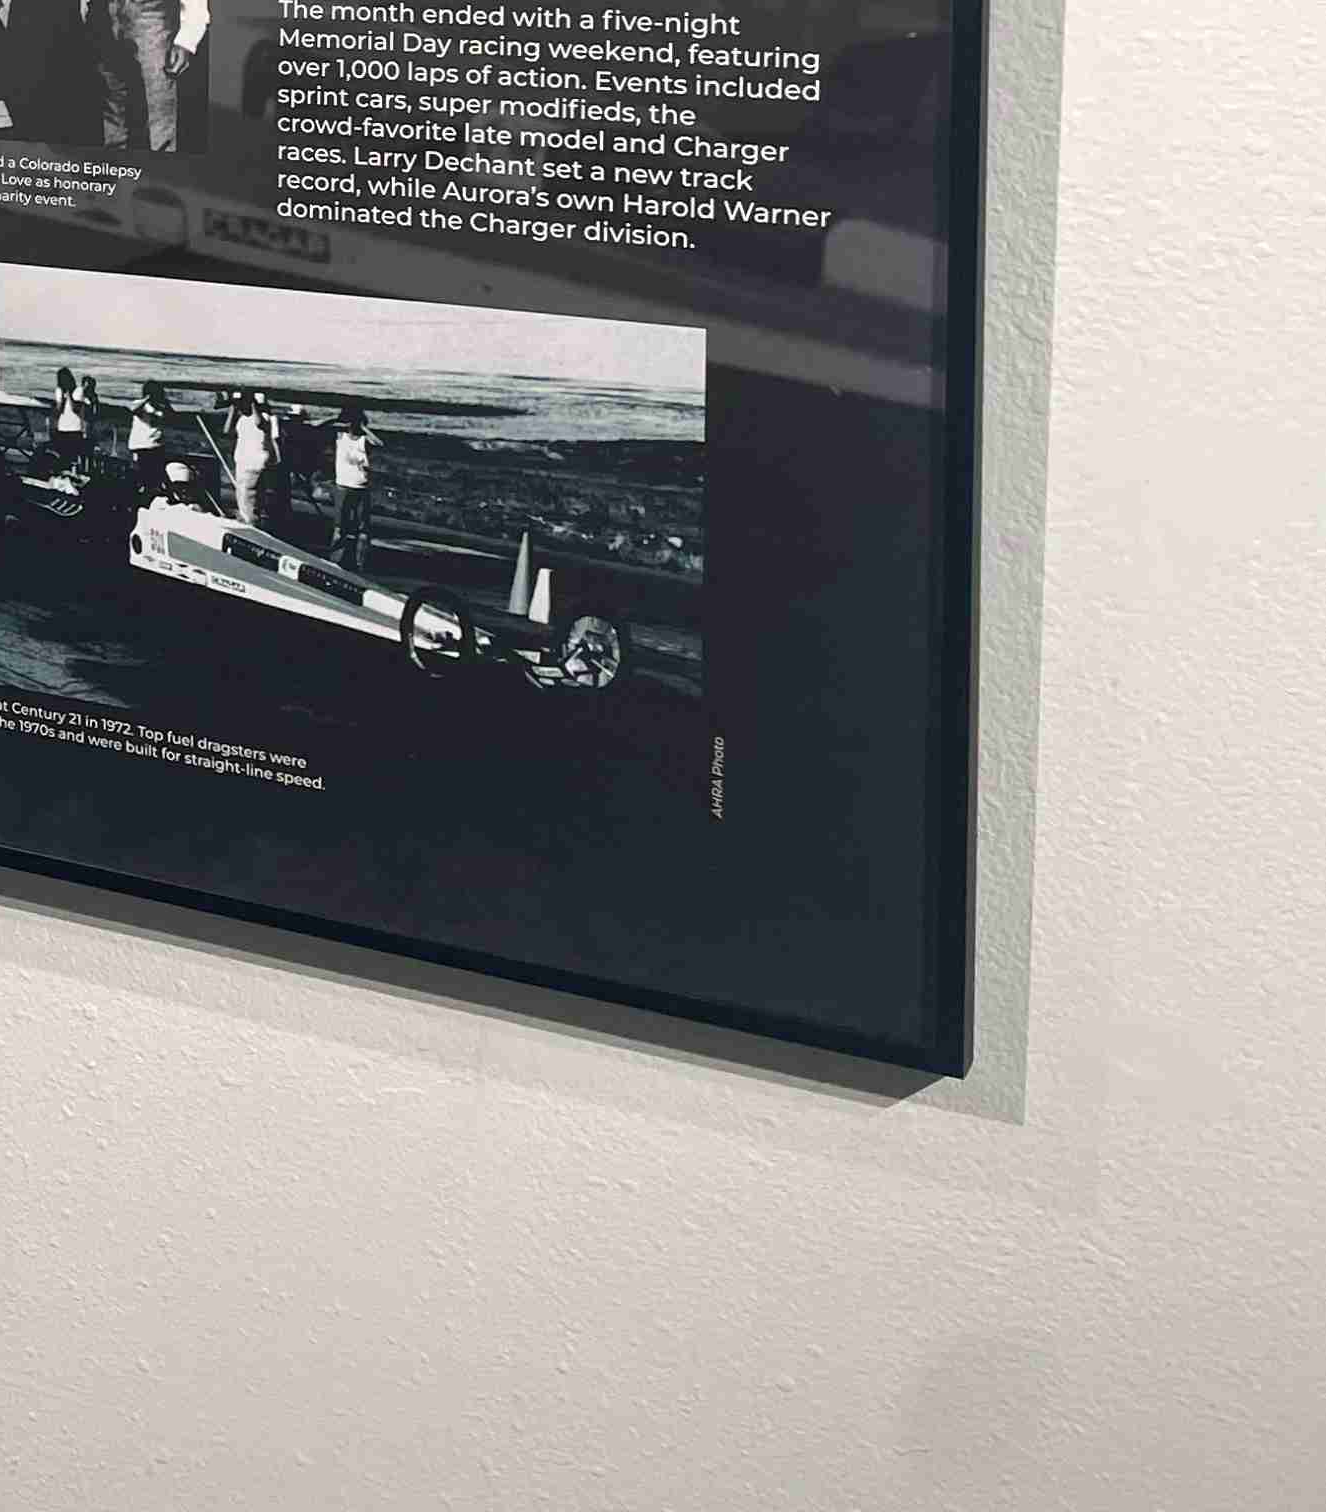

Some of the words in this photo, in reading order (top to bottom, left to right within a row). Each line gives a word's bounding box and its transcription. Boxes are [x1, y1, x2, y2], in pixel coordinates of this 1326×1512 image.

[331, 2, 414, 23] month
[422, 4, 504, 26] ended
[511, 6, 571, 29] with
[579, 14, 594, 30] a
[601, 9, 740, 39] five-night
[279, 27, 394, 51] Memorial
[403, 32, 452, 58] Day
[459, 35, 540, 62] racing
[548, 39, 680, 67] weekend,
[687, 43, 820, 75] featuring
[0, 172, 32, 187] Love
[35, 177, 51, 188] as
[53, 176, 116, 196] honorary
[7, 158, 16, 168] a
[19, 157, 80, 173] Colorado
[83, 161, 142, 180] Epilepsy
[34, 194, 76, 207] event.
[11, 701, 66, 725] Century
[68, 712, 81, 725] 21
[85, 715, 98, 728] in
[100, 718, 134, 736] 1972.
[137, 725, 164, 743] Top
[166, 730, 194, 747] fuel
[196, 737, 266, 761] dragsters
[269, 752, 307, 769] were
[18, 719, 55, 738] 1970s
[57, 729, 84, 743] and
[87, 735, 122, 751] were
[125, 739, 158, 758] built
[161, 746, 181, 761] for
[184, 754, 273, 780] straight-line
[276, 771, 325, 790] speed.
[711, 736, 724, 777] Photo
[711, 779, 723, 819] AHRA
